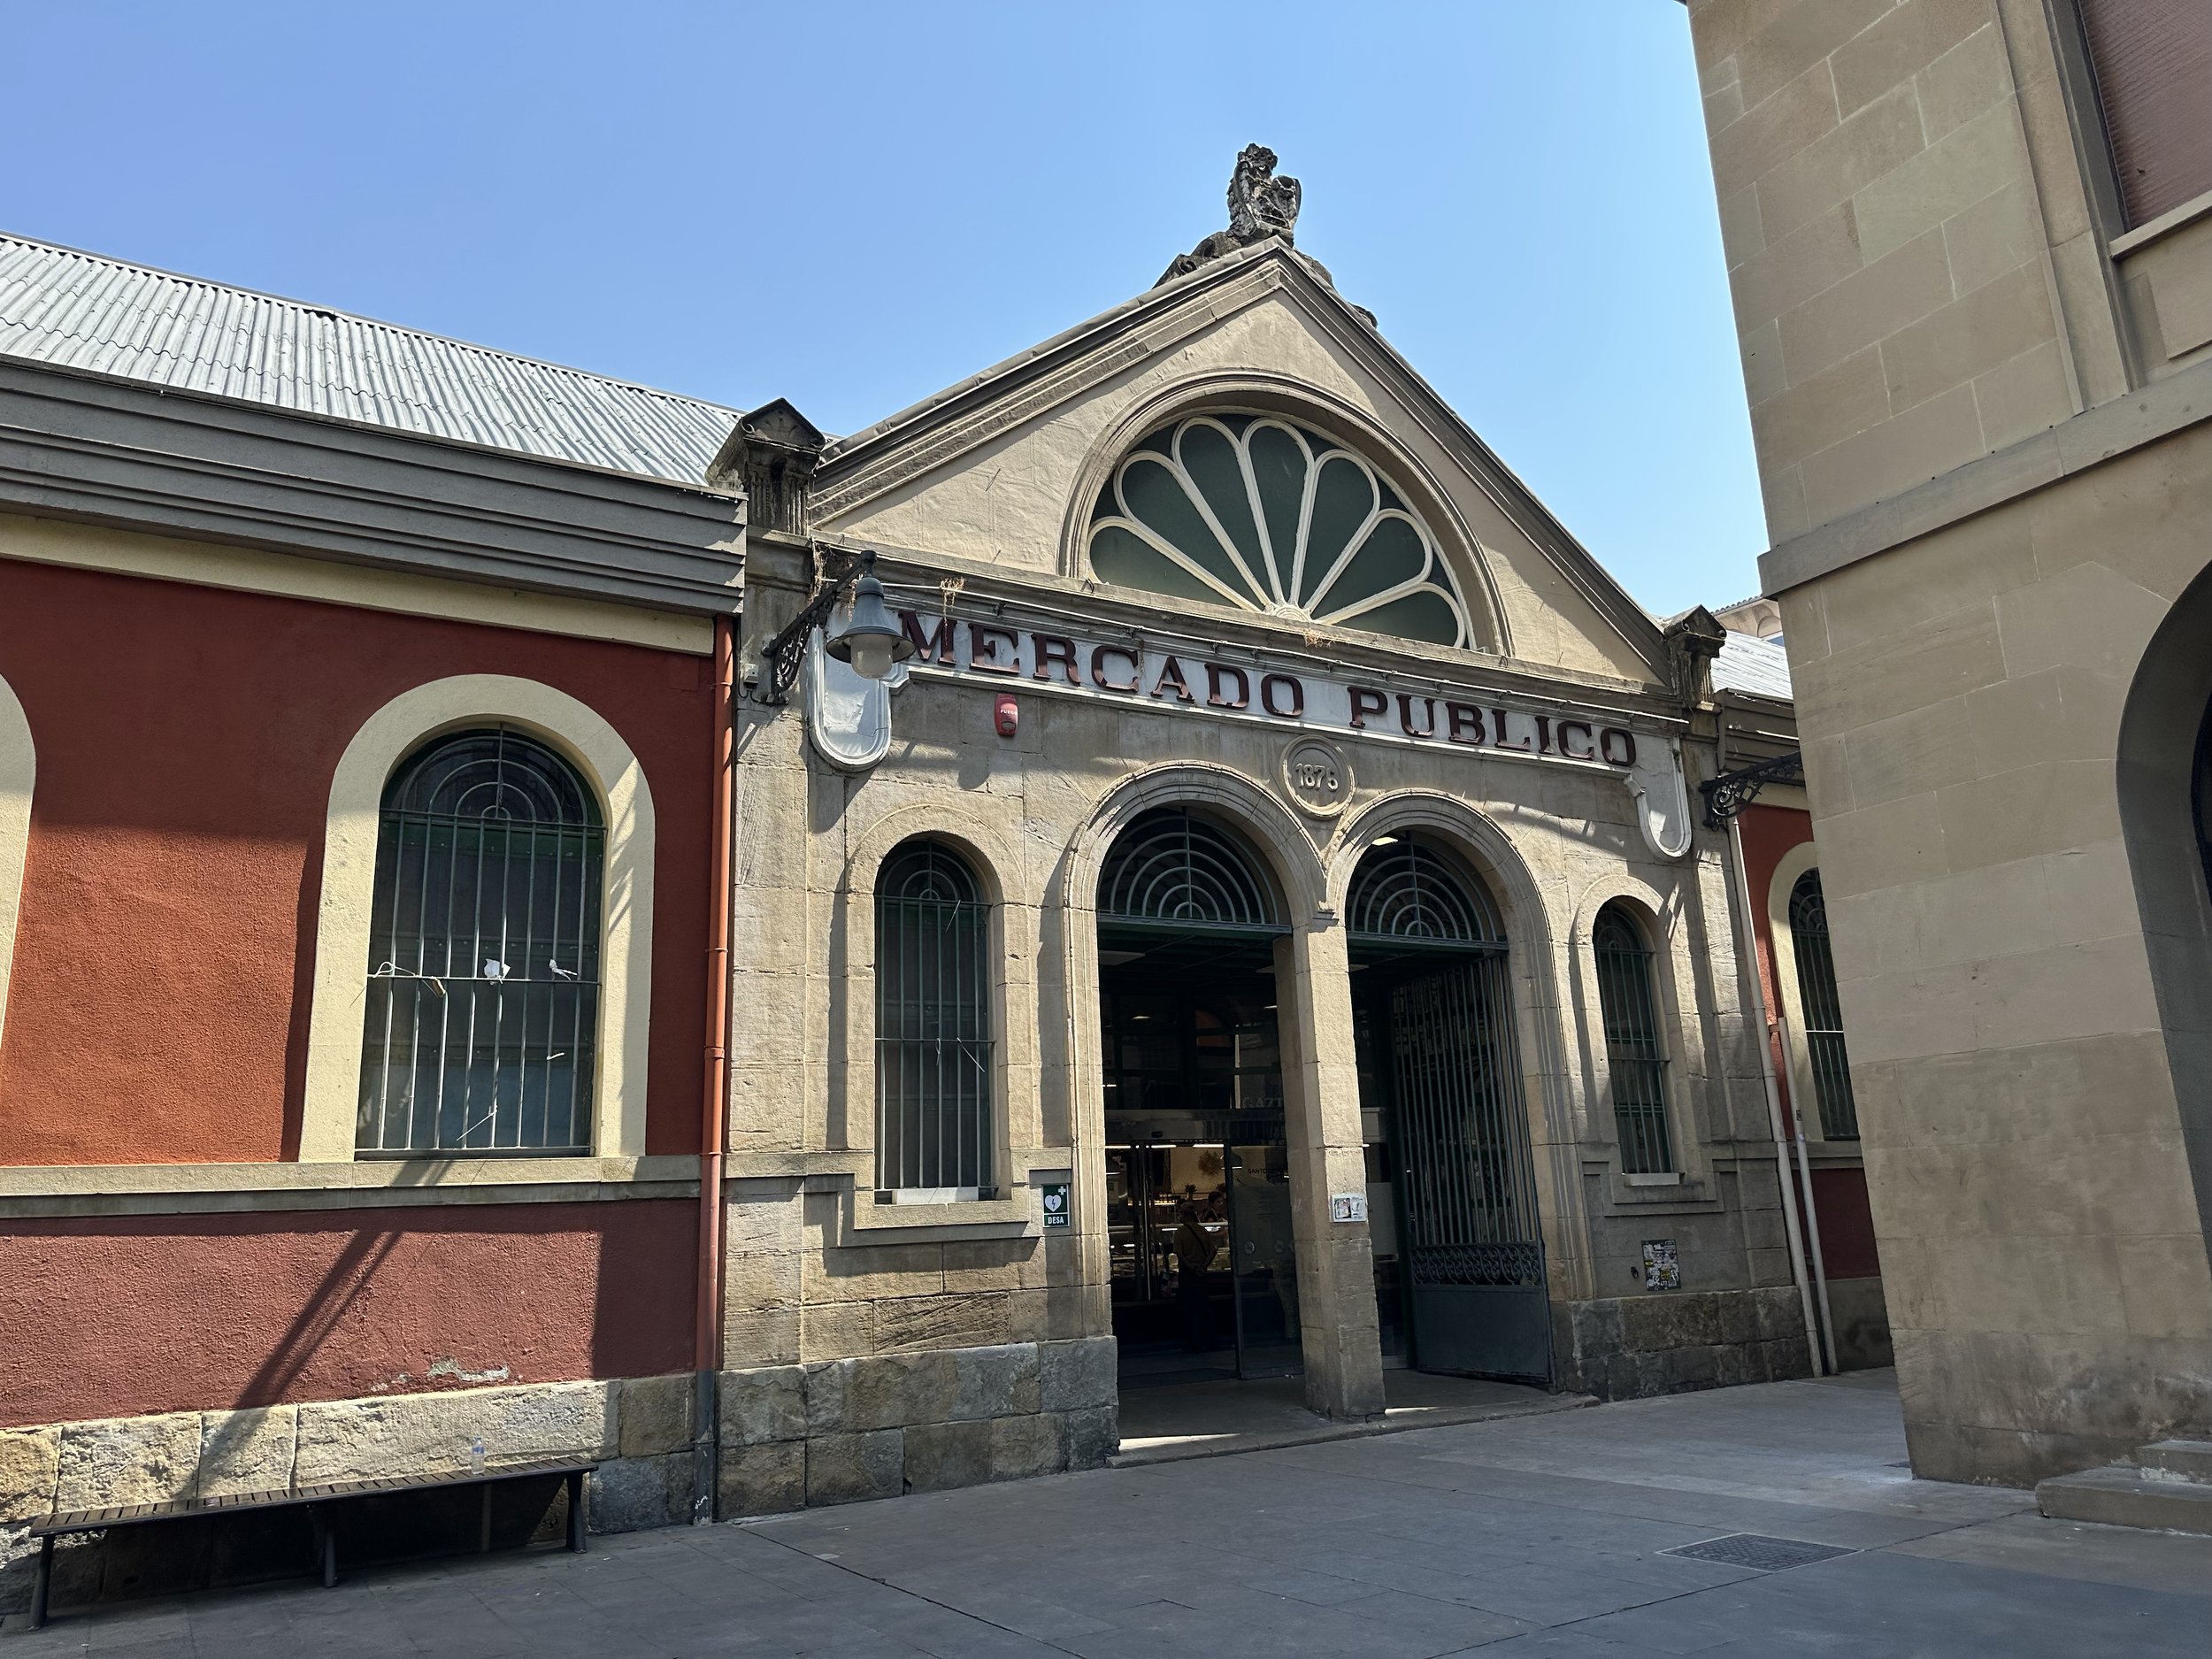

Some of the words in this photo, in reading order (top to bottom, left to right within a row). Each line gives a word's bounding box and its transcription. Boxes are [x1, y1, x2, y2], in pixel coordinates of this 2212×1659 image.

[898, 609, 1304, 718] MERCADO
[1348, 687, 1637, 767] PUBLICO
[1294, 763, 1339, 792] 1876
[1048, 1216, 1064, 1225] DESA
